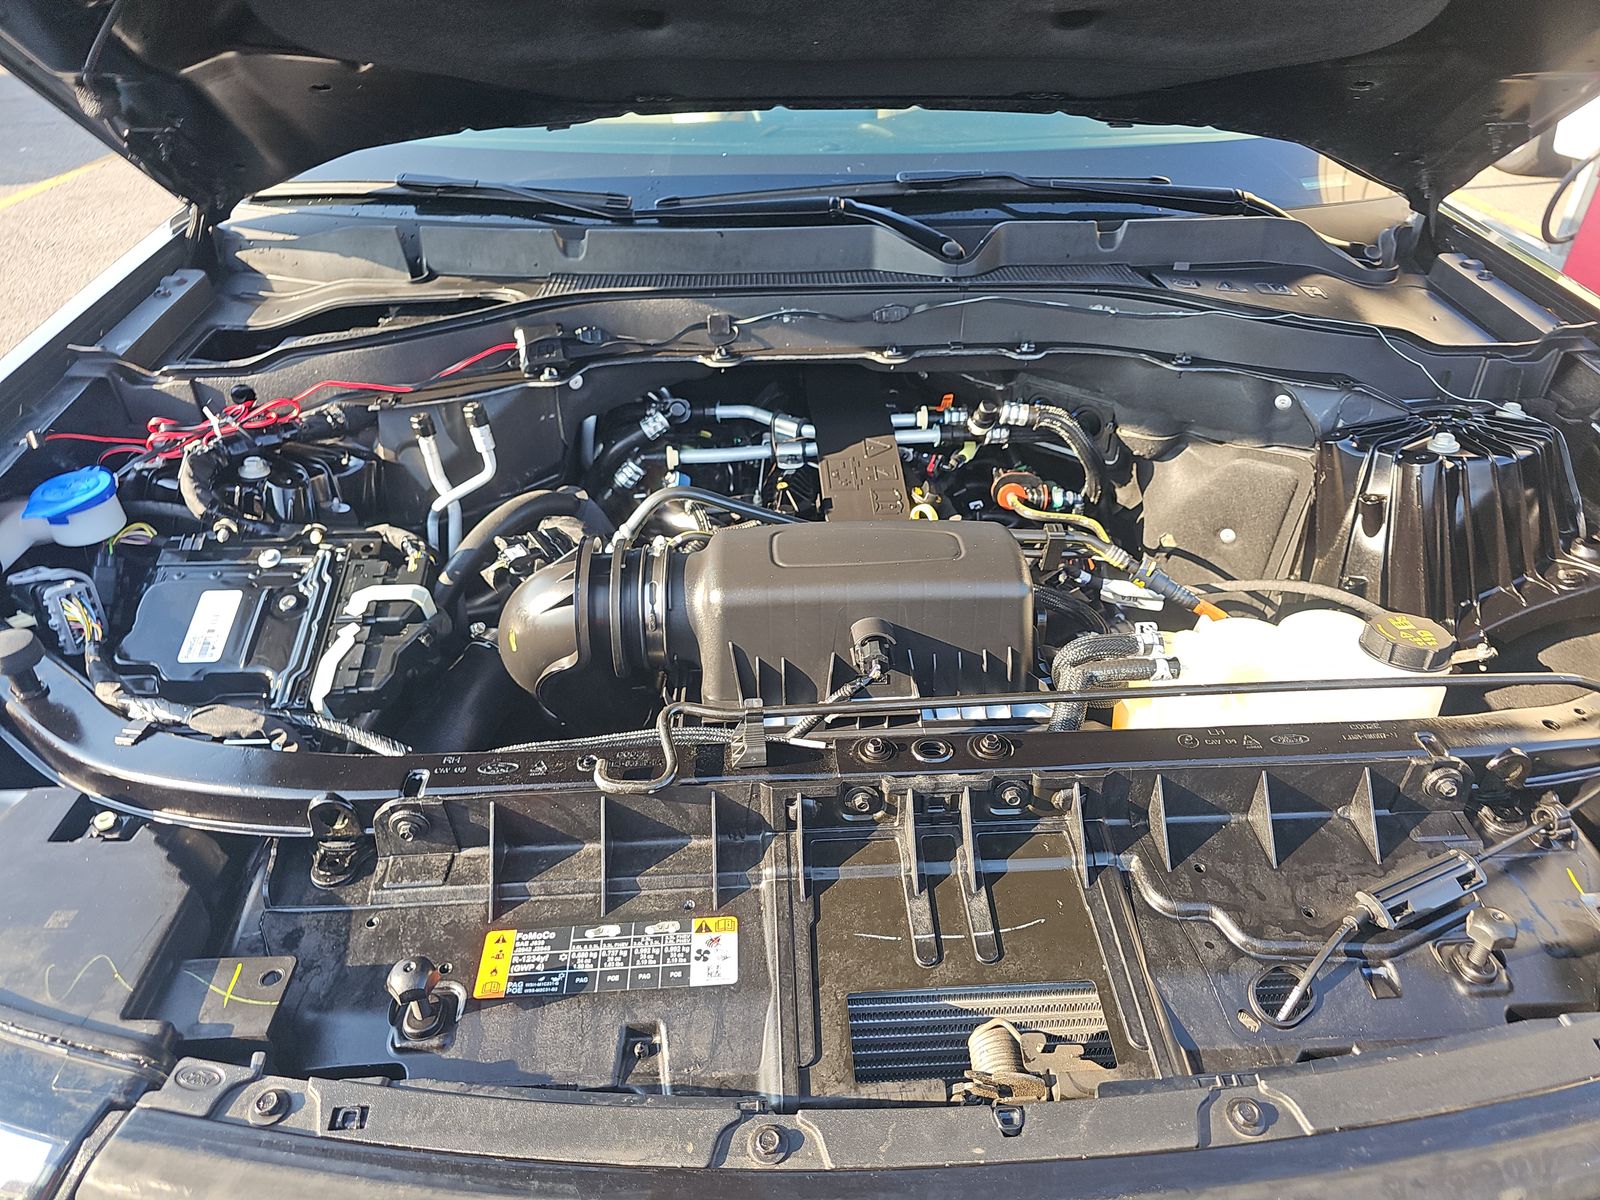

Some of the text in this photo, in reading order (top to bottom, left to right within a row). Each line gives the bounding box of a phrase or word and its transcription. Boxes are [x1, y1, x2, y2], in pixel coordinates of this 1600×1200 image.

[516, 932, 556, 940] FoMoCo
[512, 954, 550, 964] R-1234yf
[510, 966, 534, 974] (GWP
